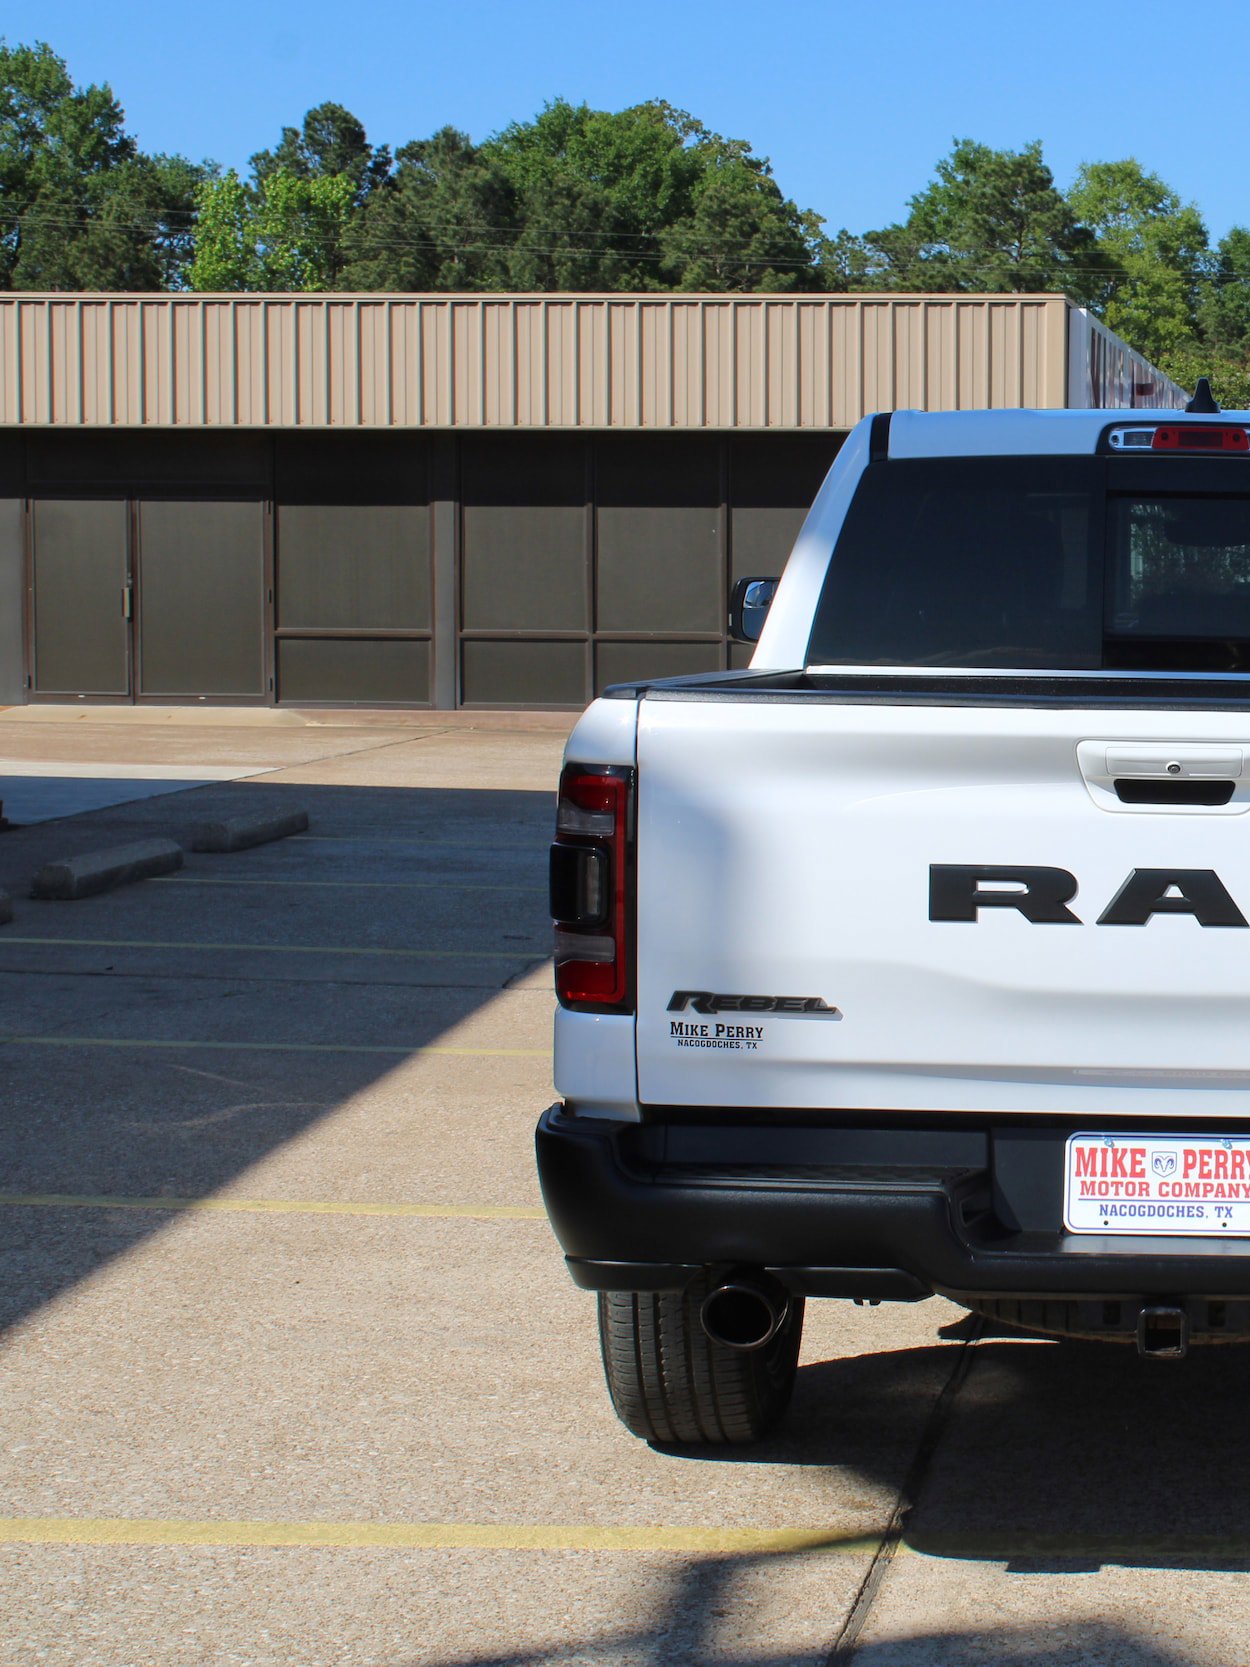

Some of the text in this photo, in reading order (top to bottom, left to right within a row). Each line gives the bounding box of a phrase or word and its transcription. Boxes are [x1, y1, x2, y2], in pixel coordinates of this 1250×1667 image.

[666, 990, 838, 1015] REBEL
[746, 1041, 758, 1050] TX
[1075, 1147, 1147, 1178] MIKE
[1080, 1180, 1150, 1197] MOTOR
[1099, 1204, 1233, 1218] NACOGDOCHES, TX
